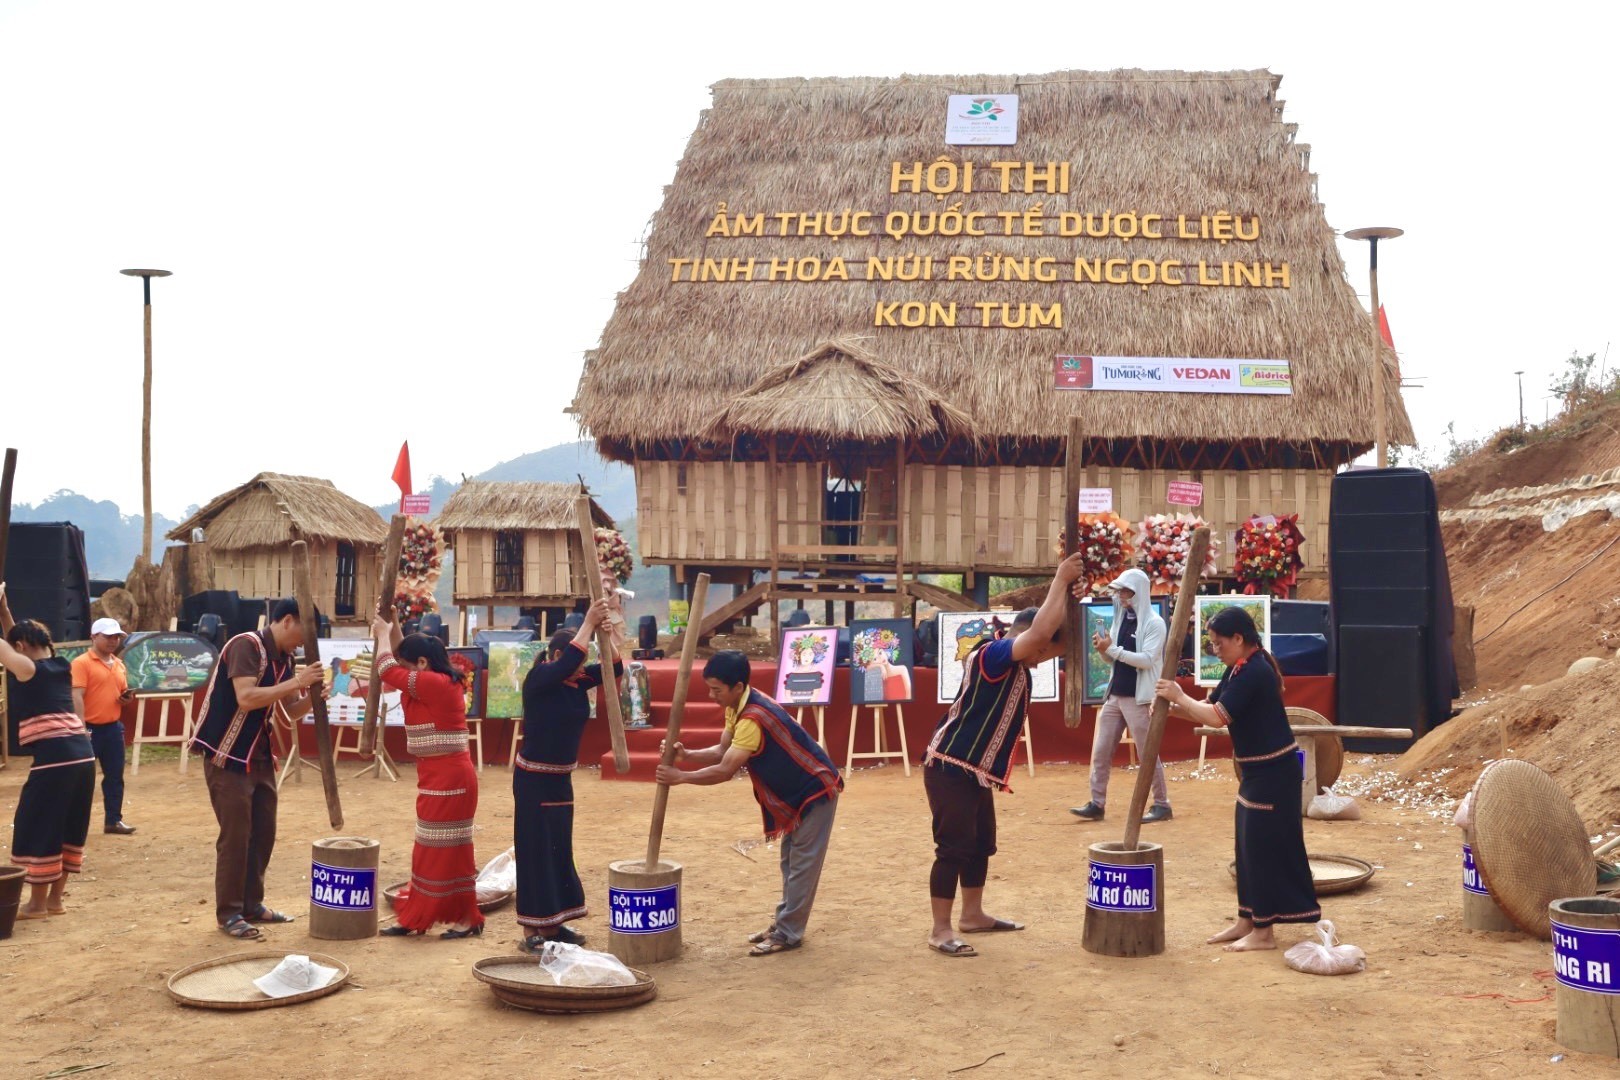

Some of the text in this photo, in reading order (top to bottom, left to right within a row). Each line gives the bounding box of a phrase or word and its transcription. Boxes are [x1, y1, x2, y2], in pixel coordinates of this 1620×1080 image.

[890, 155, 1070, 200] HỘI THI
[705, 202, 1260, 244] ẨM THỰC QUỐC TẾ DƯỢC LIỆU
[667, 251, 1291, 291] TINH HOA NÚI RỪNG NGỌC LINH
[874, 301, 1062, 328] KON TUM
[1173, 367, 1231, 380] VEDAN
[1254, 371, 1290, 380] Bidrico
[313, 869, 354, 885] ĐỘI THI
[1104, 871, 1127, 883] THI
[315, 884, 345, 904] ĐĂK
[613, 894, 656, 908] ĐỘI THI
[1102, 886, 1120, 905] RƠ
[1123, 885, 1149, 906] ÔNG
[615, 908, 643, 928] ĐĂK
[648, 907, 675, 928] SAO
[1553, 931, 1578, 950] THI
[1587, 960, 1611, 984] RI
